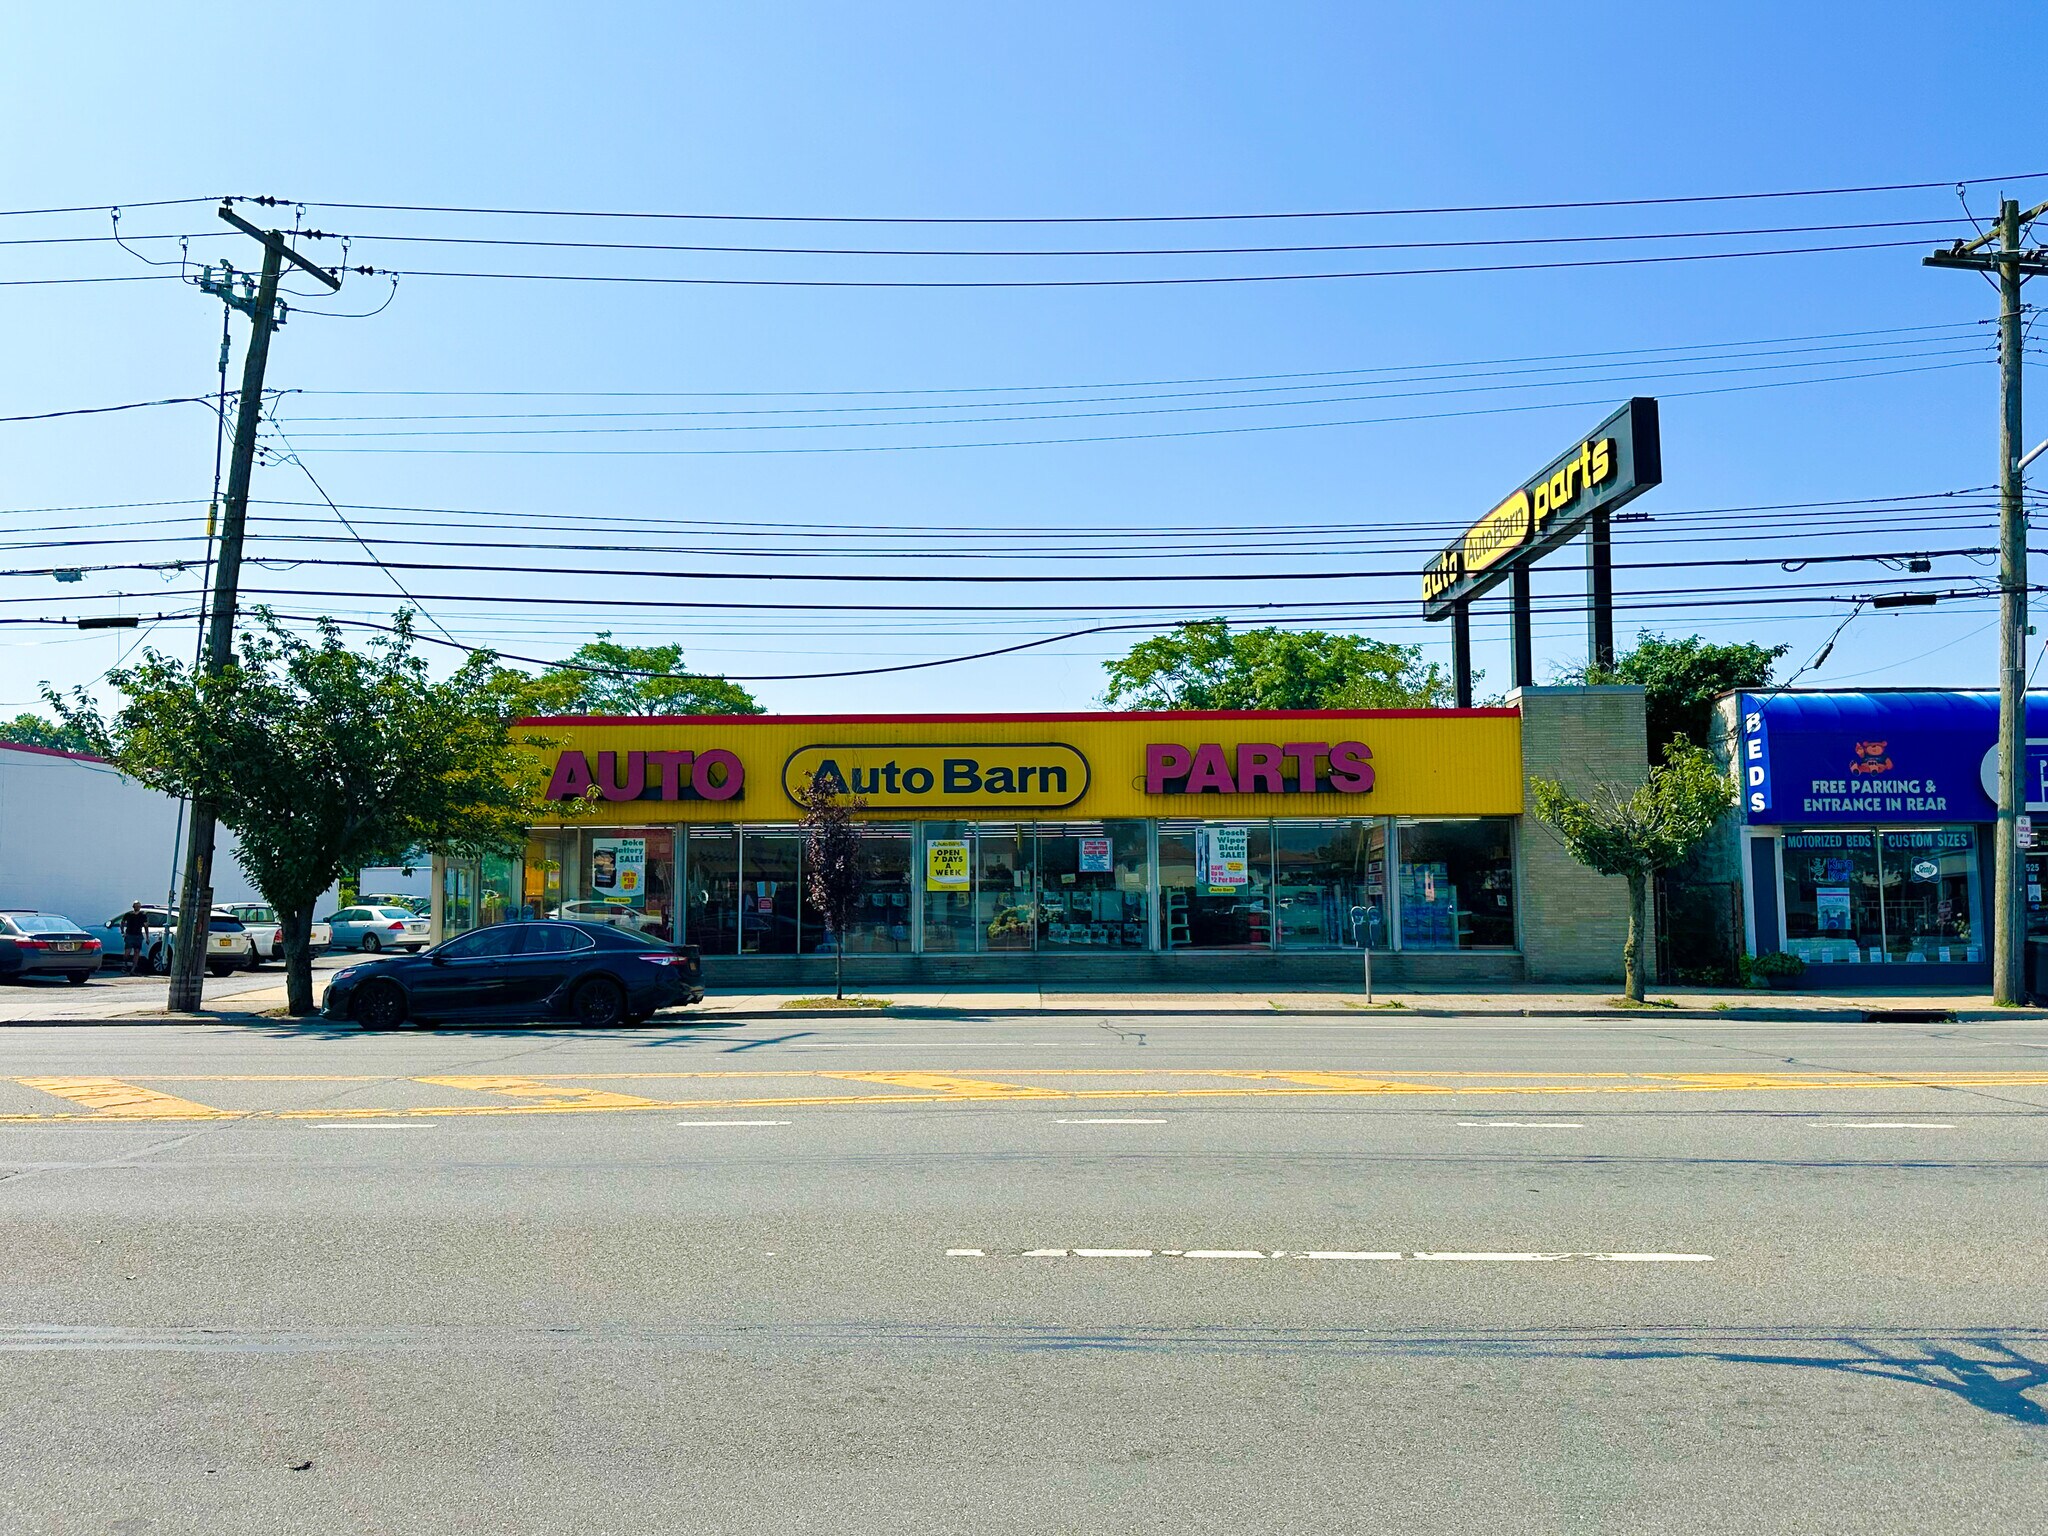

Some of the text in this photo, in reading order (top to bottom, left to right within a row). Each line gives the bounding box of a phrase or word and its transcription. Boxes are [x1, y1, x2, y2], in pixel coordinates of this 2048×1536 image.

[1423, 551, 1457, 601] auto
[1534, 438, 1608, 532] parts
[1146, 741, 1375, 794] PARTS
[1746, 712, 1766, 813] BEDS
[545, 749, 745, 801] AUTO
[812, 759, 1067, 794] Auto Barn
[1812, 779, 1936, 794] FREE PARKING &
[1803, 797, 1947, 811] ENTRANCE IN REAR
[1217, 836, 1246, 844] Wiper
[1787, 834, 1967, 848] MOTORIZED BEDS CUSTOM SIZES
[619, 855, 643, 863] SALE!
[2025, 863, 2040, 872] 525
